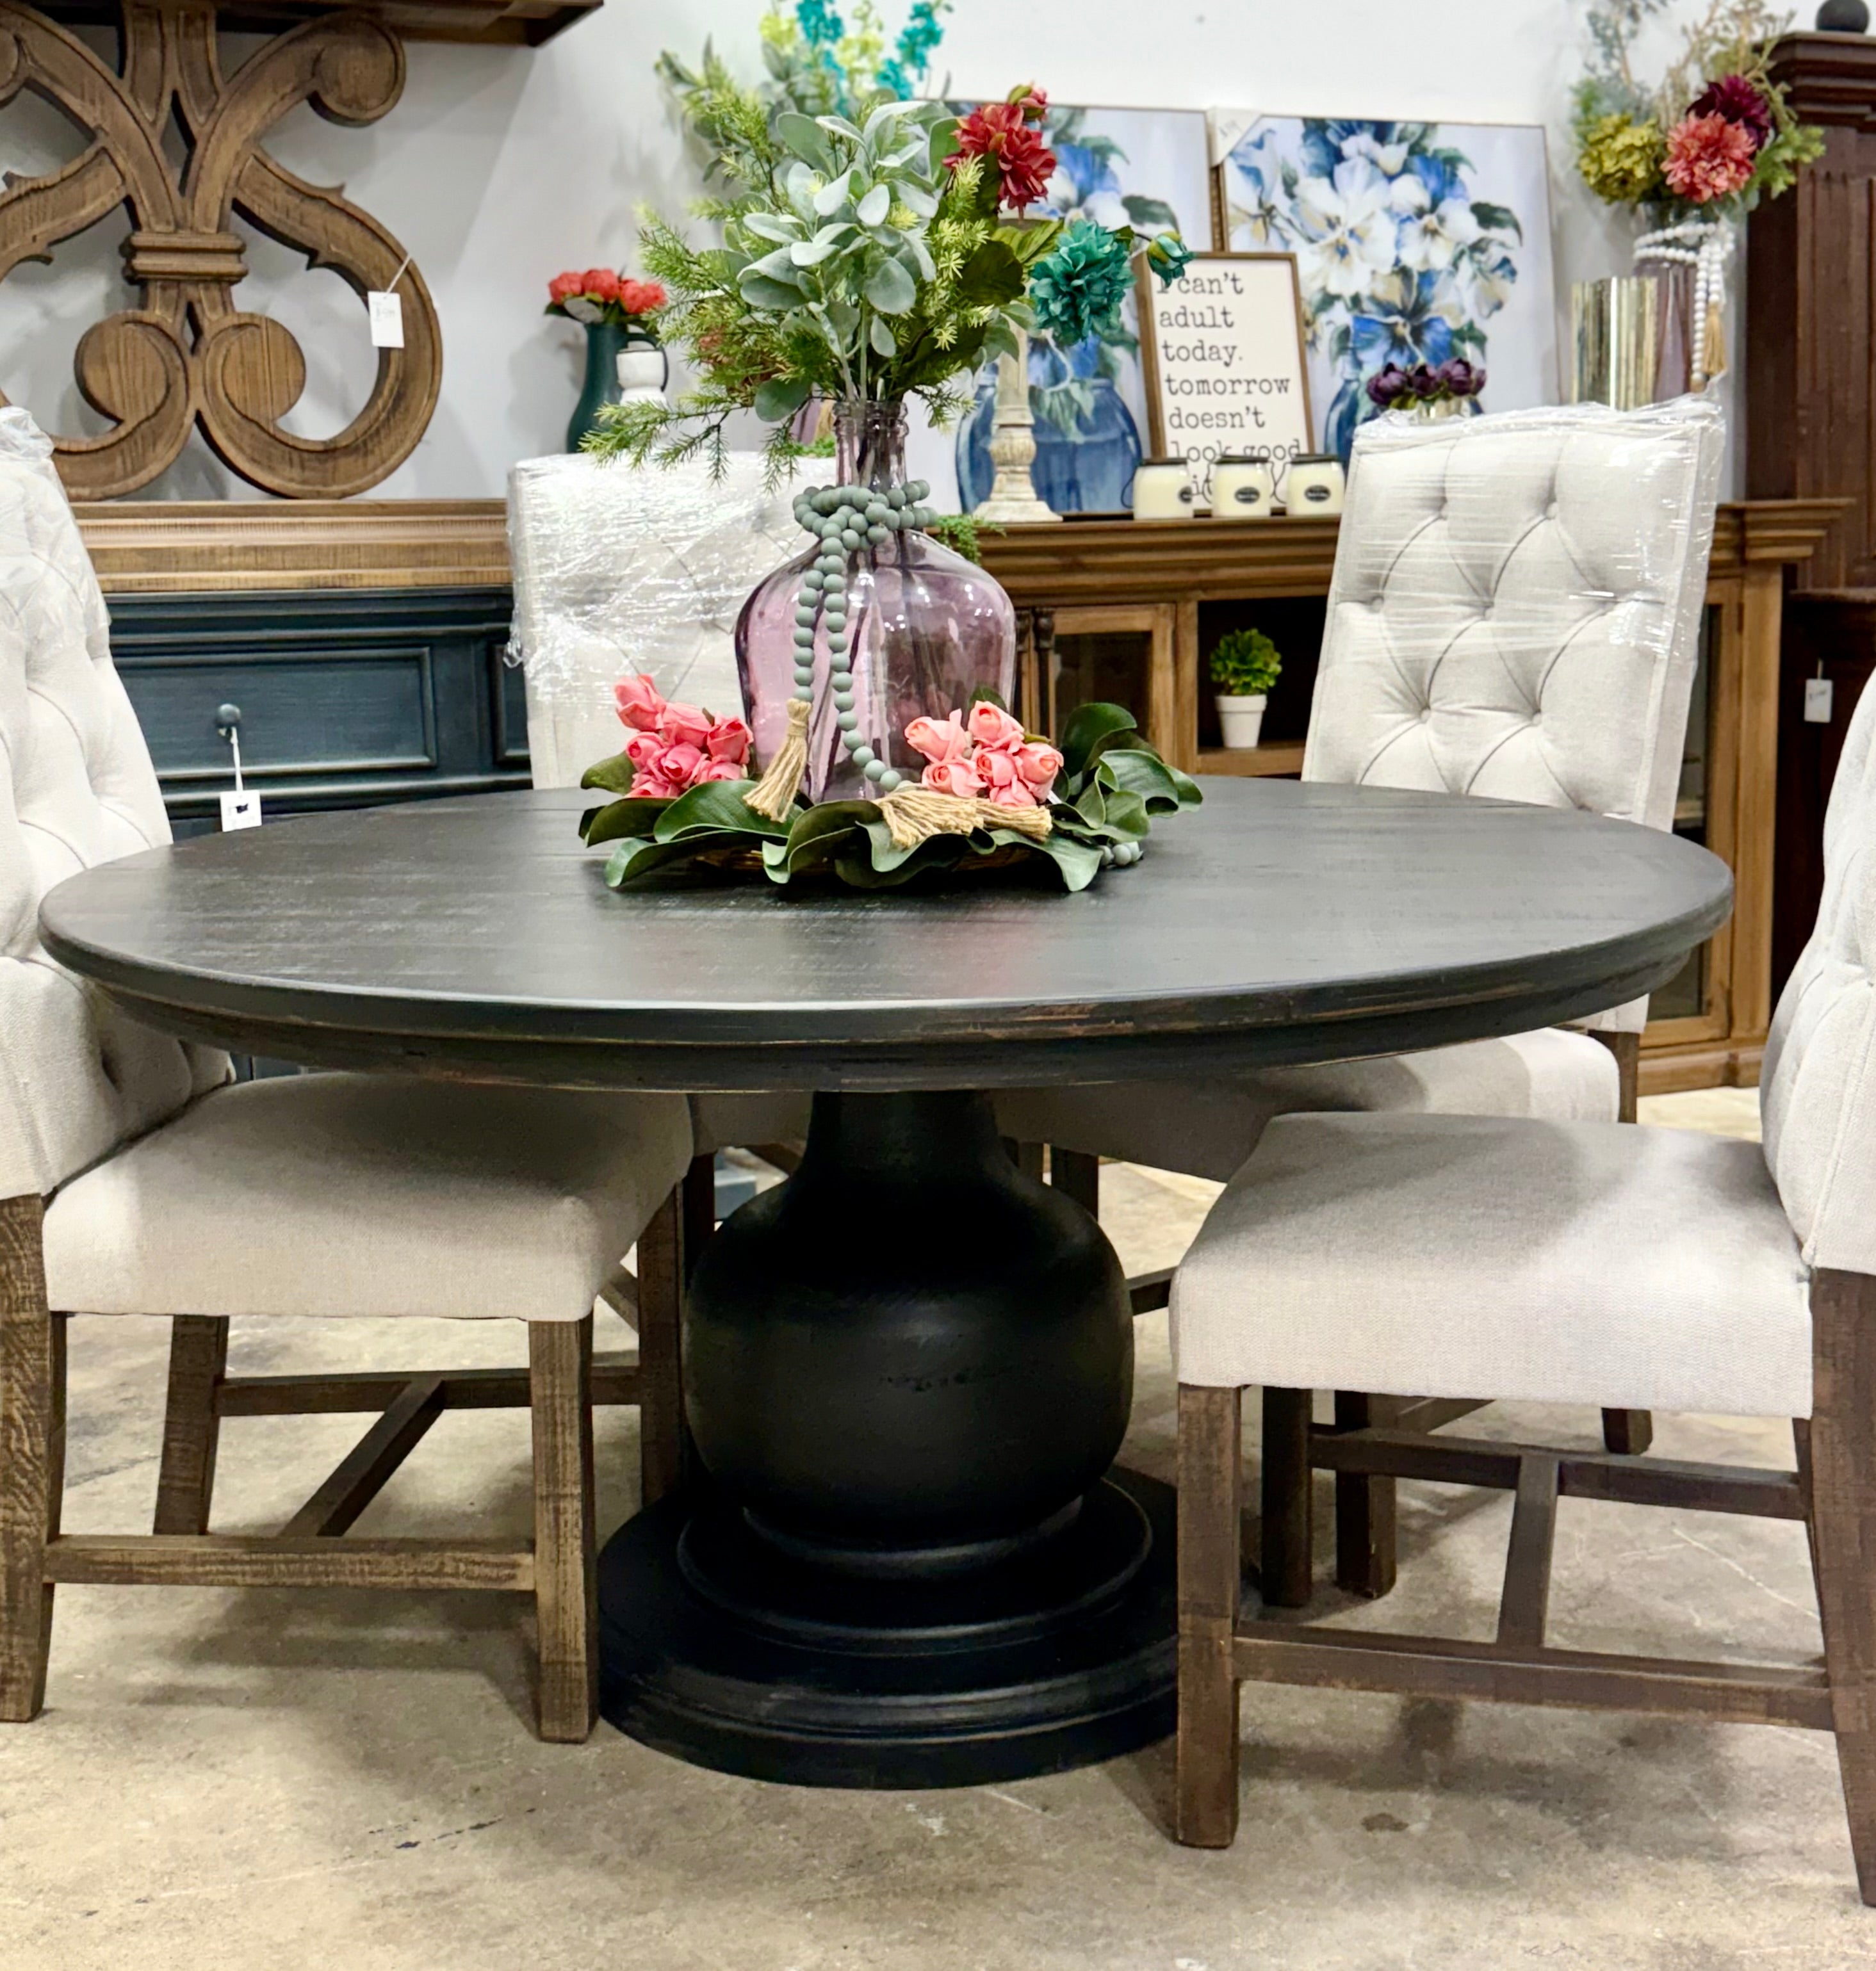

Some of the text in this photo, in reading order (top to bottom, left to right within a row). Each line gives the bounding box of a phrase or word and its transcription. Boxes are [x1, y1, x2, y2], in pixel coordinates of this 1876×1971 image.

[1177, 272, 1244, 295] can't
[1159, 306, 1235, 328] adult
[1162, 339, 1243, 367] today.
[1165, 373, 1291, 396] tomorrow
[1169, 406, 1266, 429] doesn't
[1171, 440, 1232, 462] look
